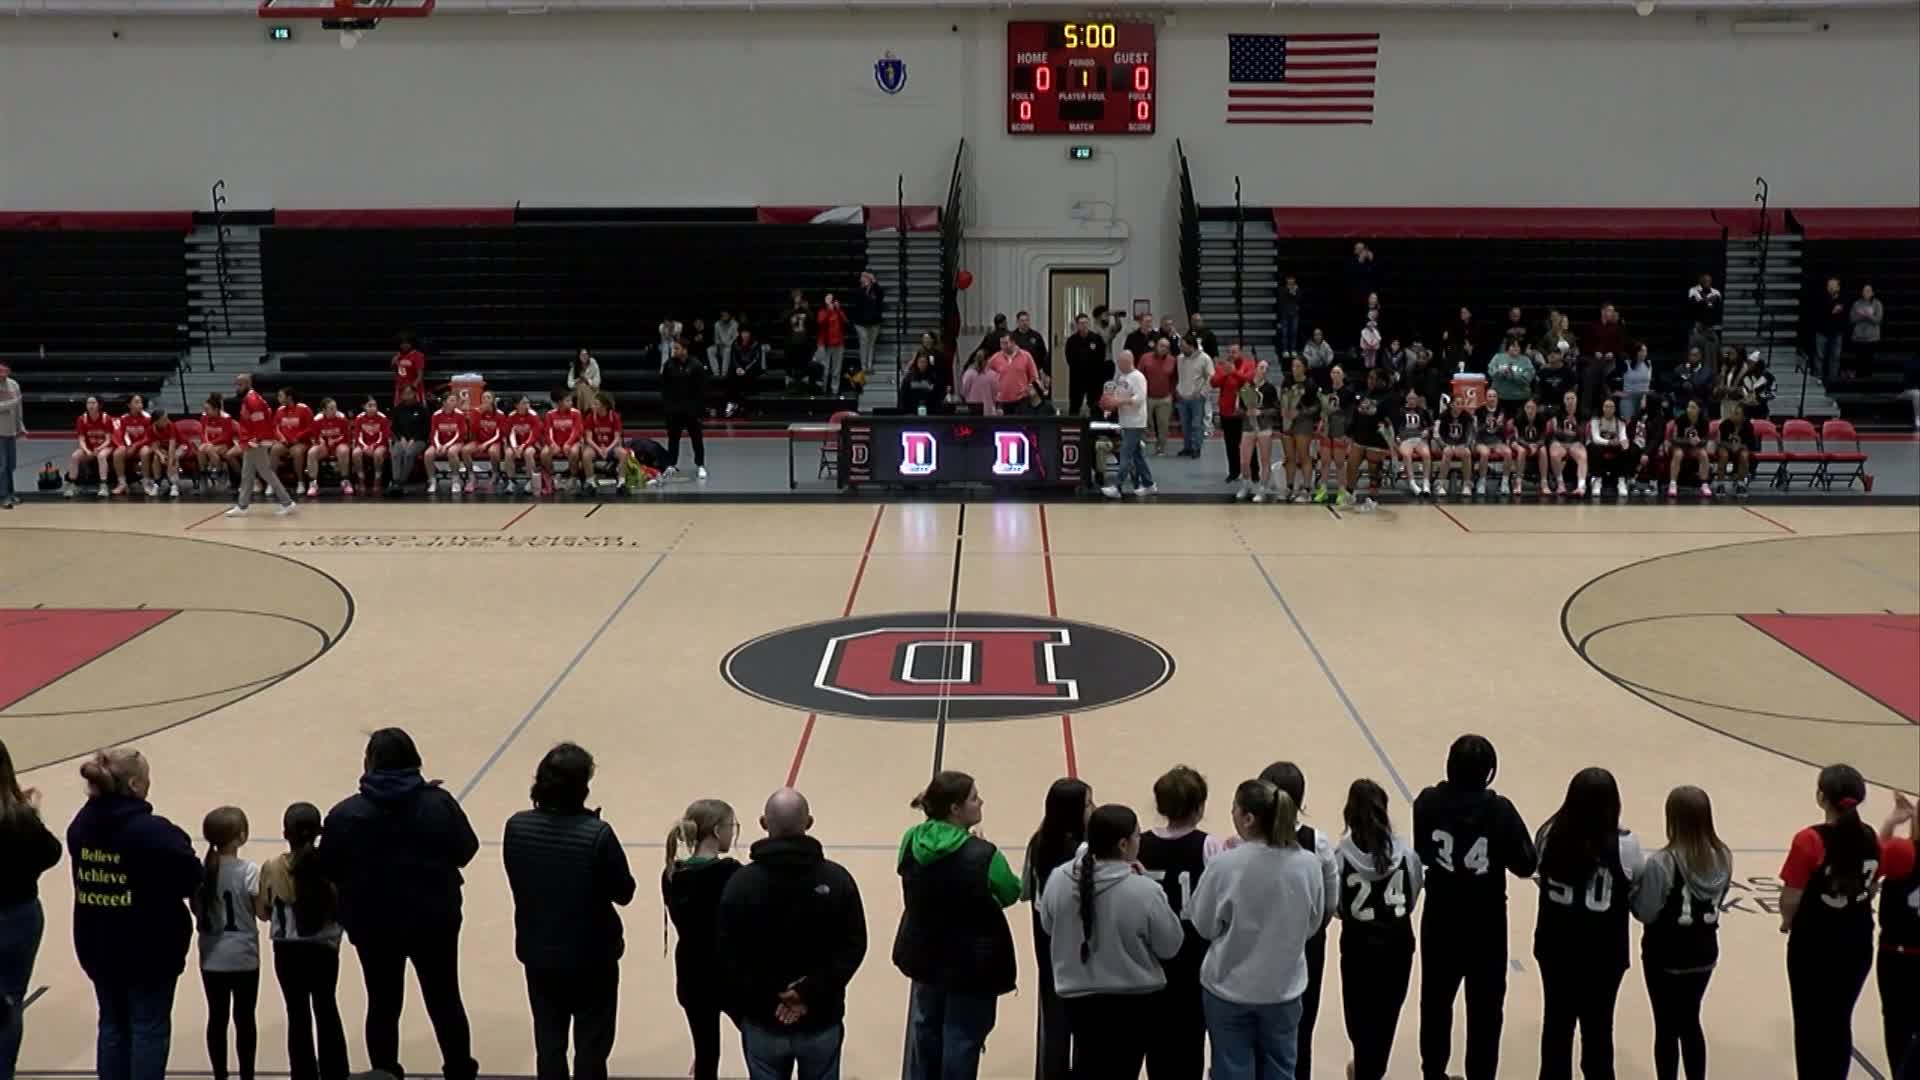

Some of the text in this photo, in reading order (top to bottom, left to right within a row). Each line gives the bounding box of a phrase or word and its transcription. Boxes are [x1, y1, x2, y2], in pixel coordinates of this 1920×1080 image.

[1064, 24, 1115, 48] 5:00
[1017, 53, 1048, 64] HOME
[1114, 53, 1149, 64] GUEST
[1036, 67, 1050, 91] 0
[1082, 69, 1088, 87] 1
[1135, 67, 1149, 91] 0
[1020, 101, 1032, 120] 0
[1137, 101, 1149, 120] 0
[901, 431, 936, 474] D
[994, 431, 1029, 474] D
[813, 628, 1079, 701] D
[81, 847, 121, 864] Believe
[1431, 829, 1489, 875] 34
[78, 866, 128, 884] Achieve
[77, 891, 132, 907] ucceed
[1346, 867, 1407, 919] 24
